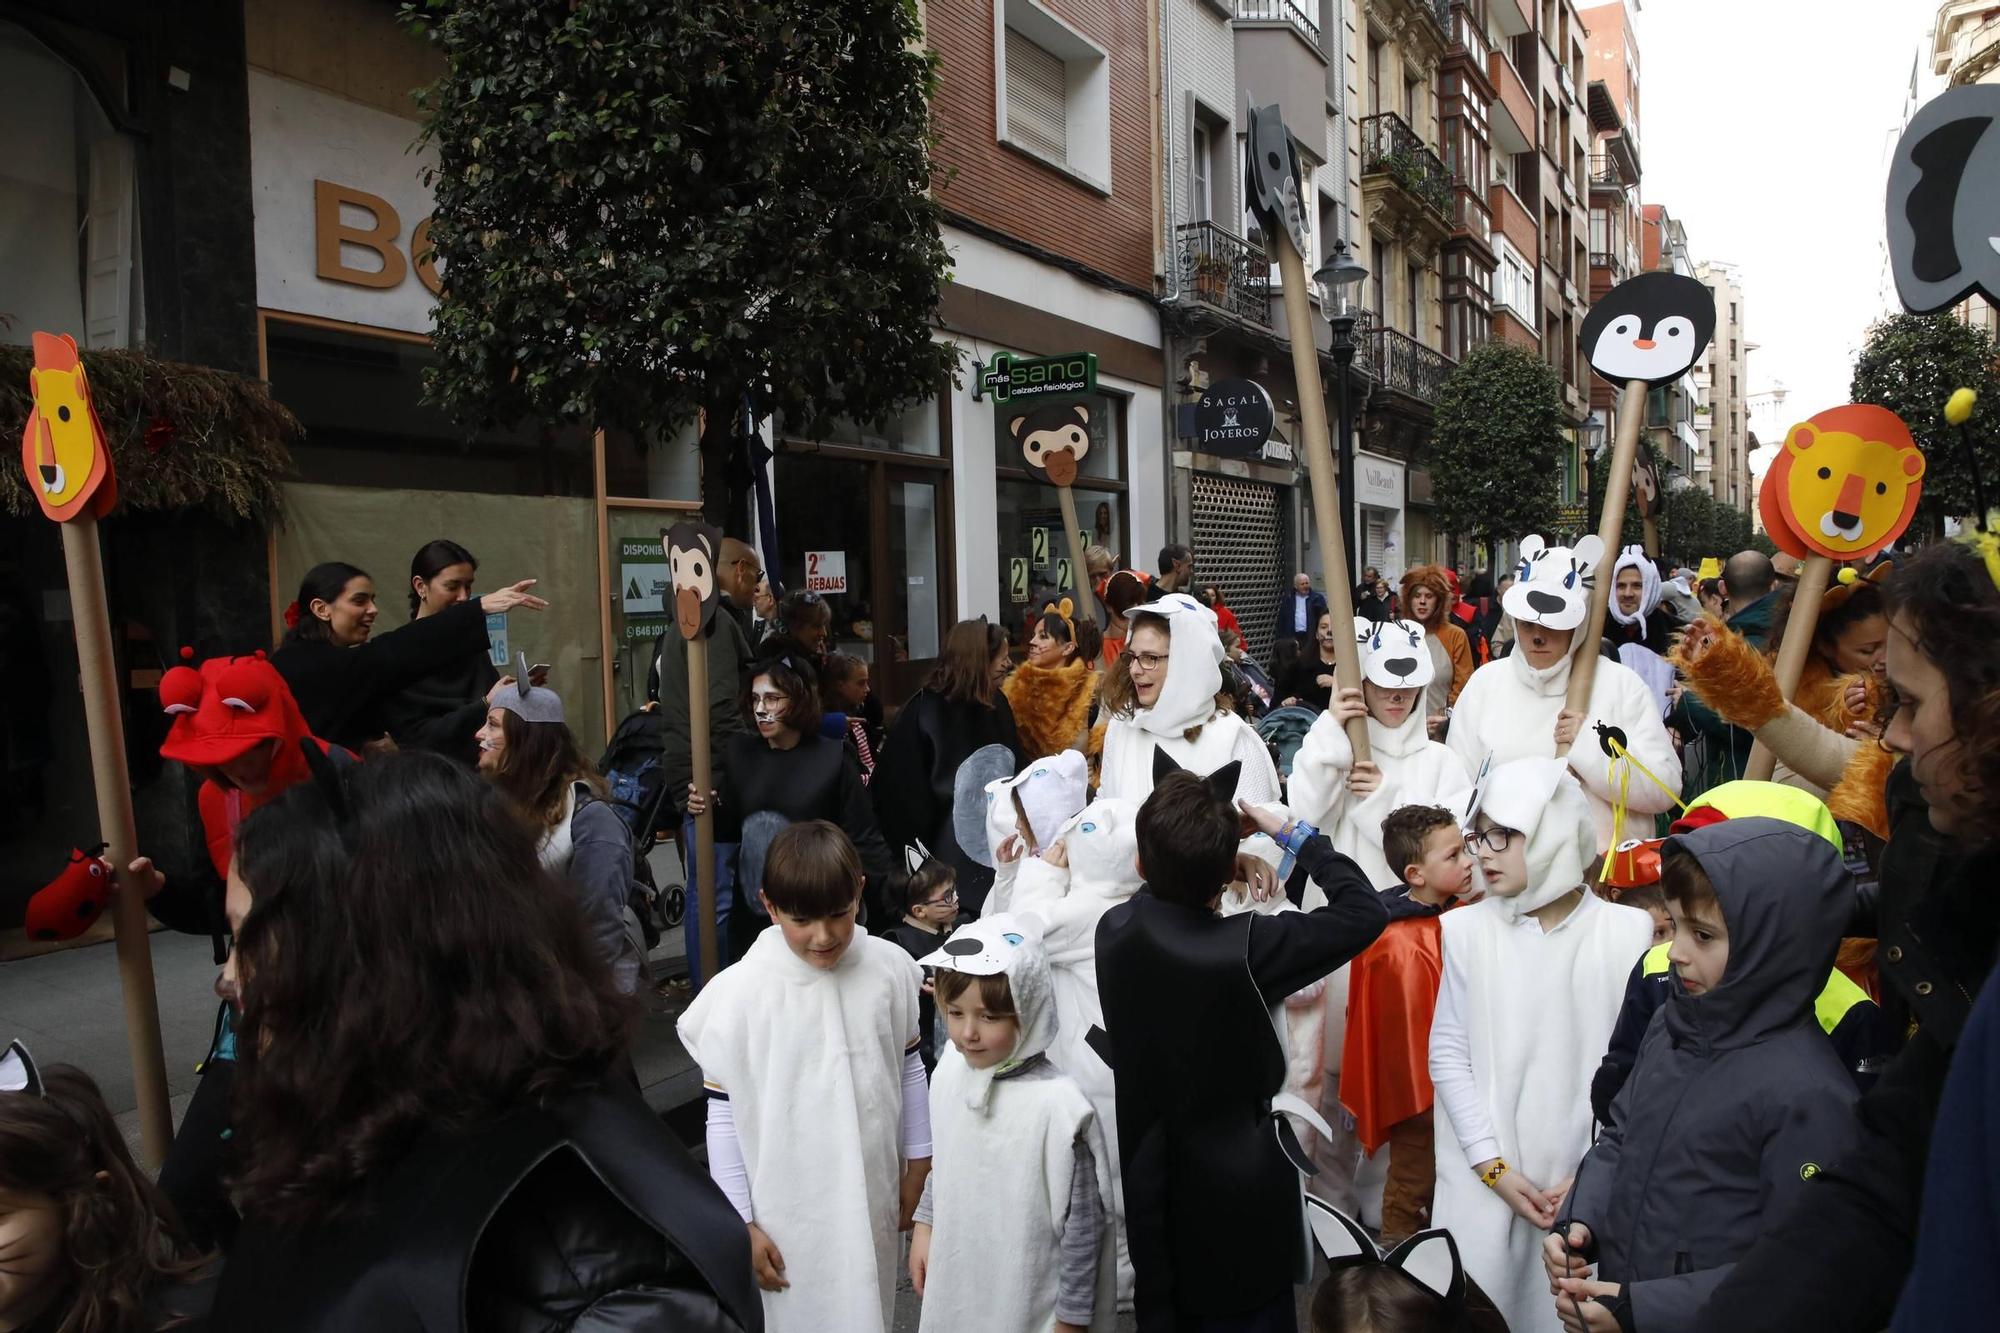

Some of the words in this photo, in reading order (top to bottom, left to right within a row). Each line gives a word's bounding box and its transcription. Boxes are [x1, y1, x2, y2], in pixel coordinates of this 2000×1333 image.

[987, 375, 1010, 384] más
[1011, 361, 1085, 385] sano
[1011, 385, 1042, 395] calzado
[1043, 381, 1085, 393] fisiológico
[1203, 395, 1259, 408] SAGAL
[1204, 427, 1259, 442] JOYEROS
[1262, 440, 1293, 461] JOYEROS
[808, 576, 845, 591] REBAJAS
